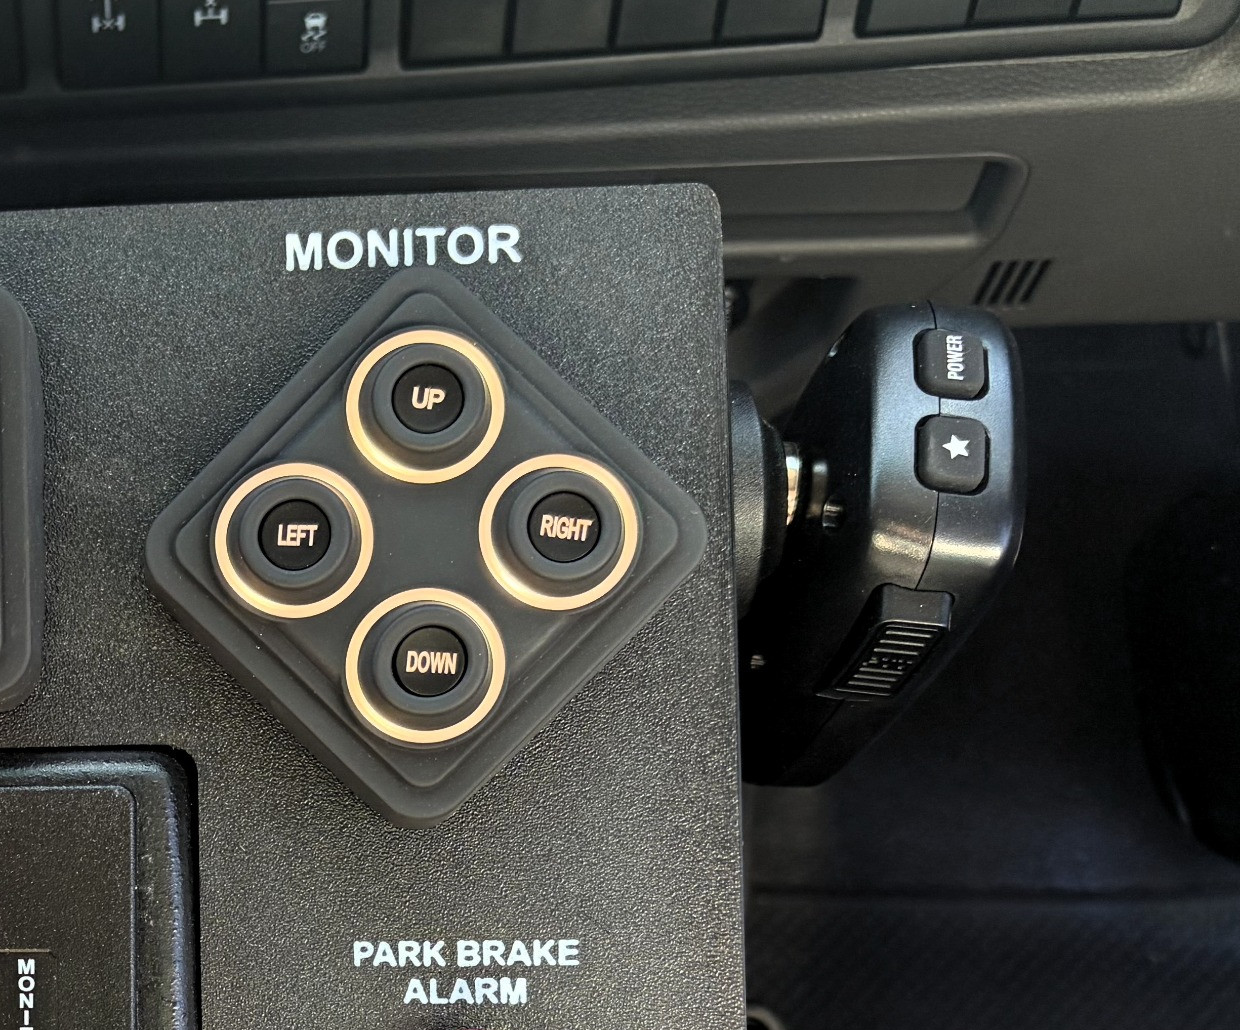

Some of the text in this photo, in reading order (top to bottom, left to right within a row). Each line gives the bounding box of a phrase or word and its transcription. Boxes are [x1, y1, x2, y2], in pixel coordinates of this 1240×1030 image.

[284, 225, 523, 271] MONITOR
[946, 334, 965, 381] POWER
[411, 386, 446, 410] UP
[276, 524, 318, 547] LEFT
[539, 514, 593, 542] RIGHT
[405, 650, 458, 675] DOWN
[352, 938, 581, 968] PARK BRAKE
[402, 976, 528, 1005] ALARM
